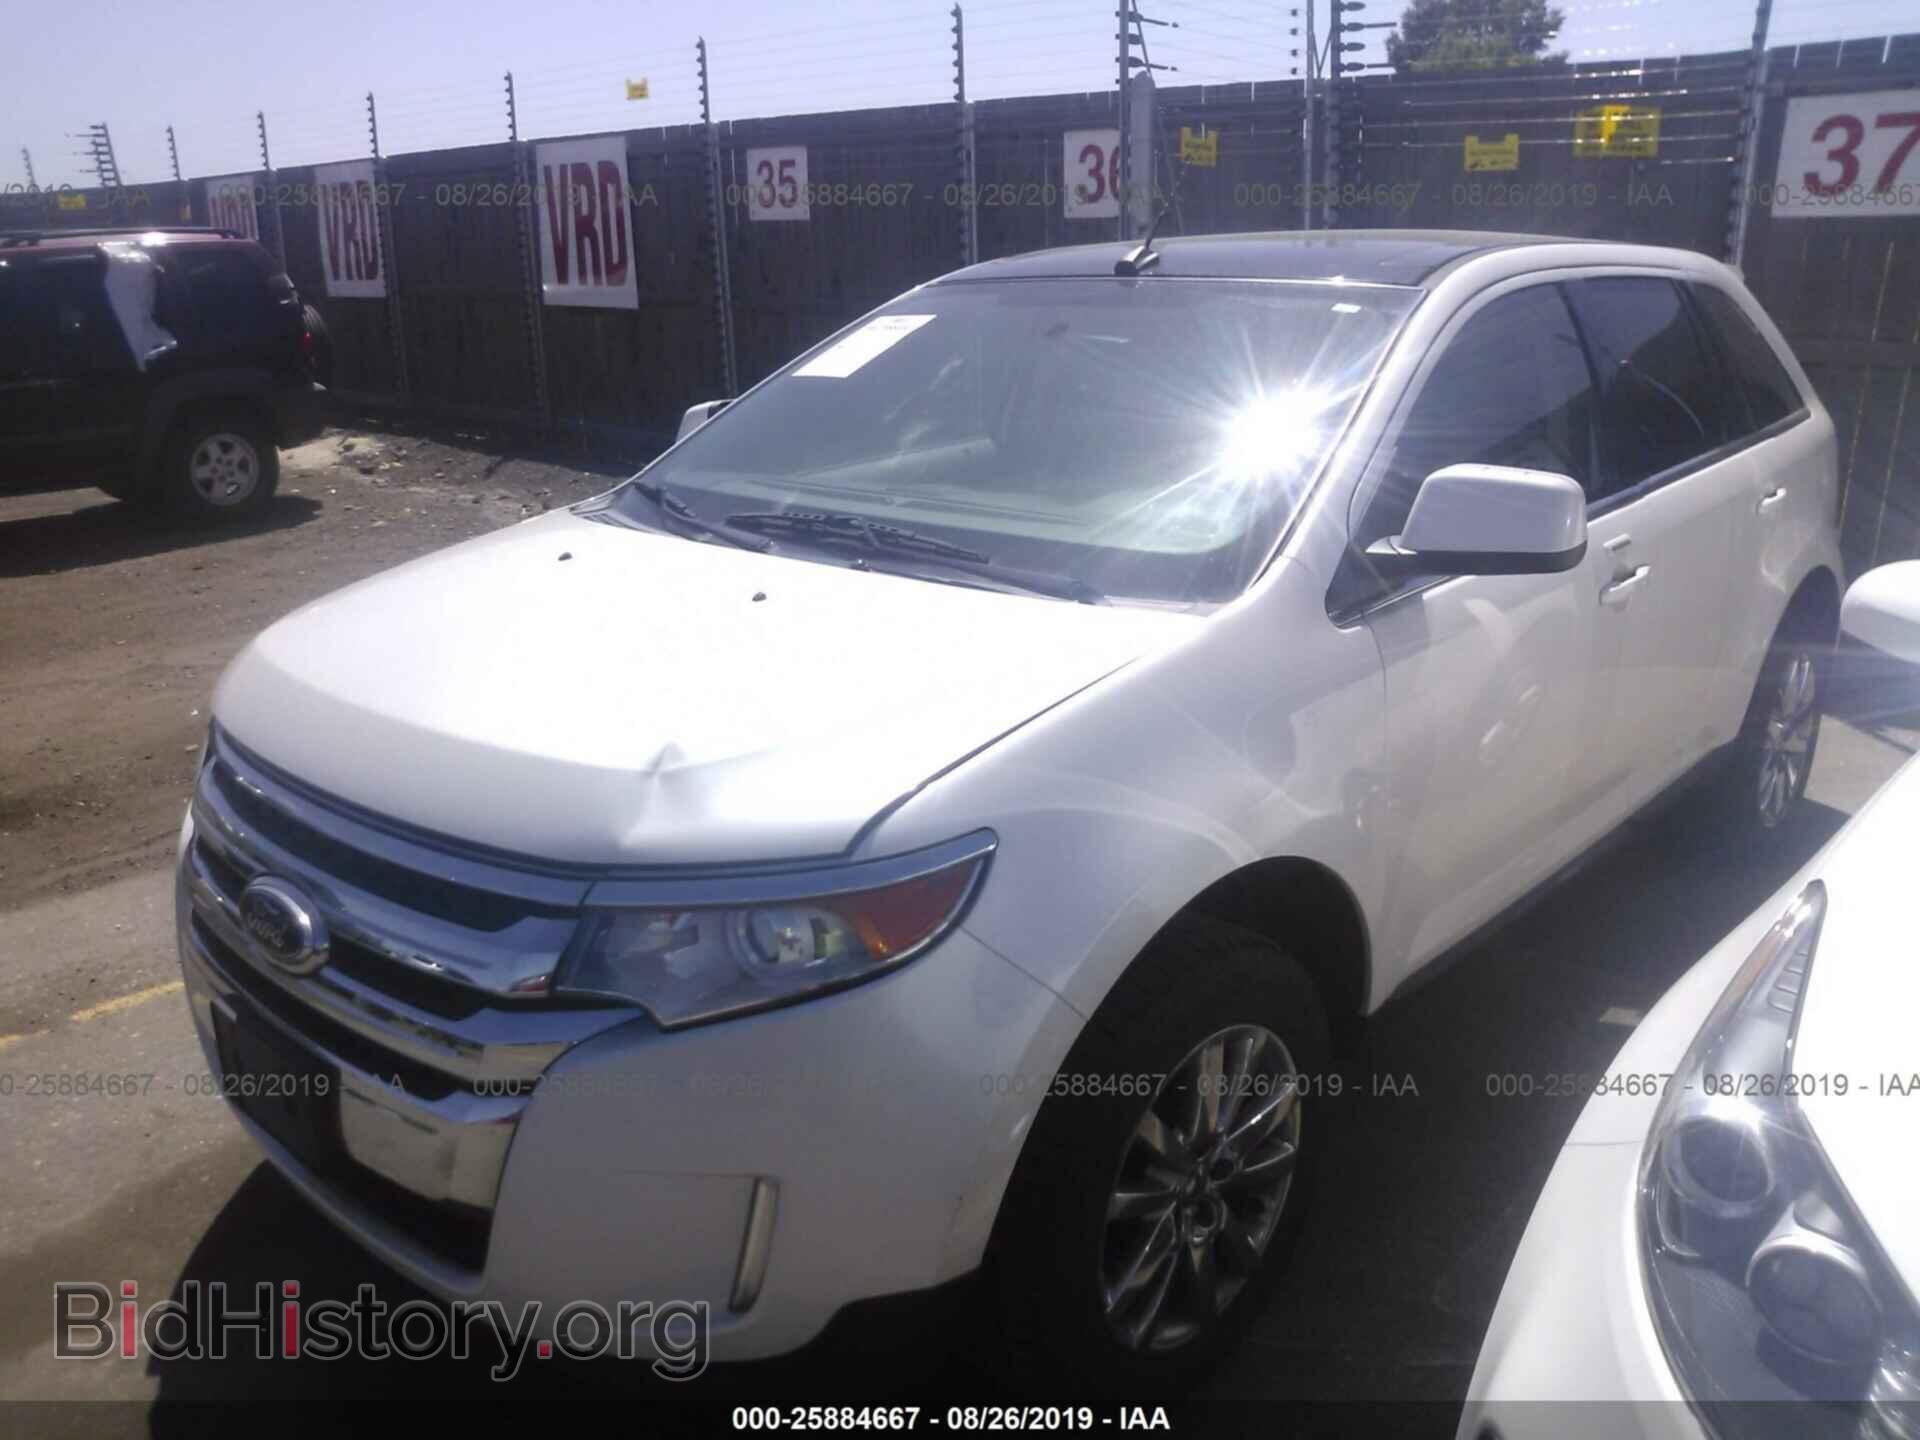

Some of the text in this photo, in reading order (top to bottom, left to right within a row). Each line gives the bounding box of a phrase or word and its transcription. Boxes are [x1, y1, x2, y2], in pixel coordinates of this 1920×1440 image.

[757, 159, 799, 208] 35
[1803, 113, 1920, 198] 37
[319, 179, 379, 281] VRD
[543, 159, 629, 286] VRD
